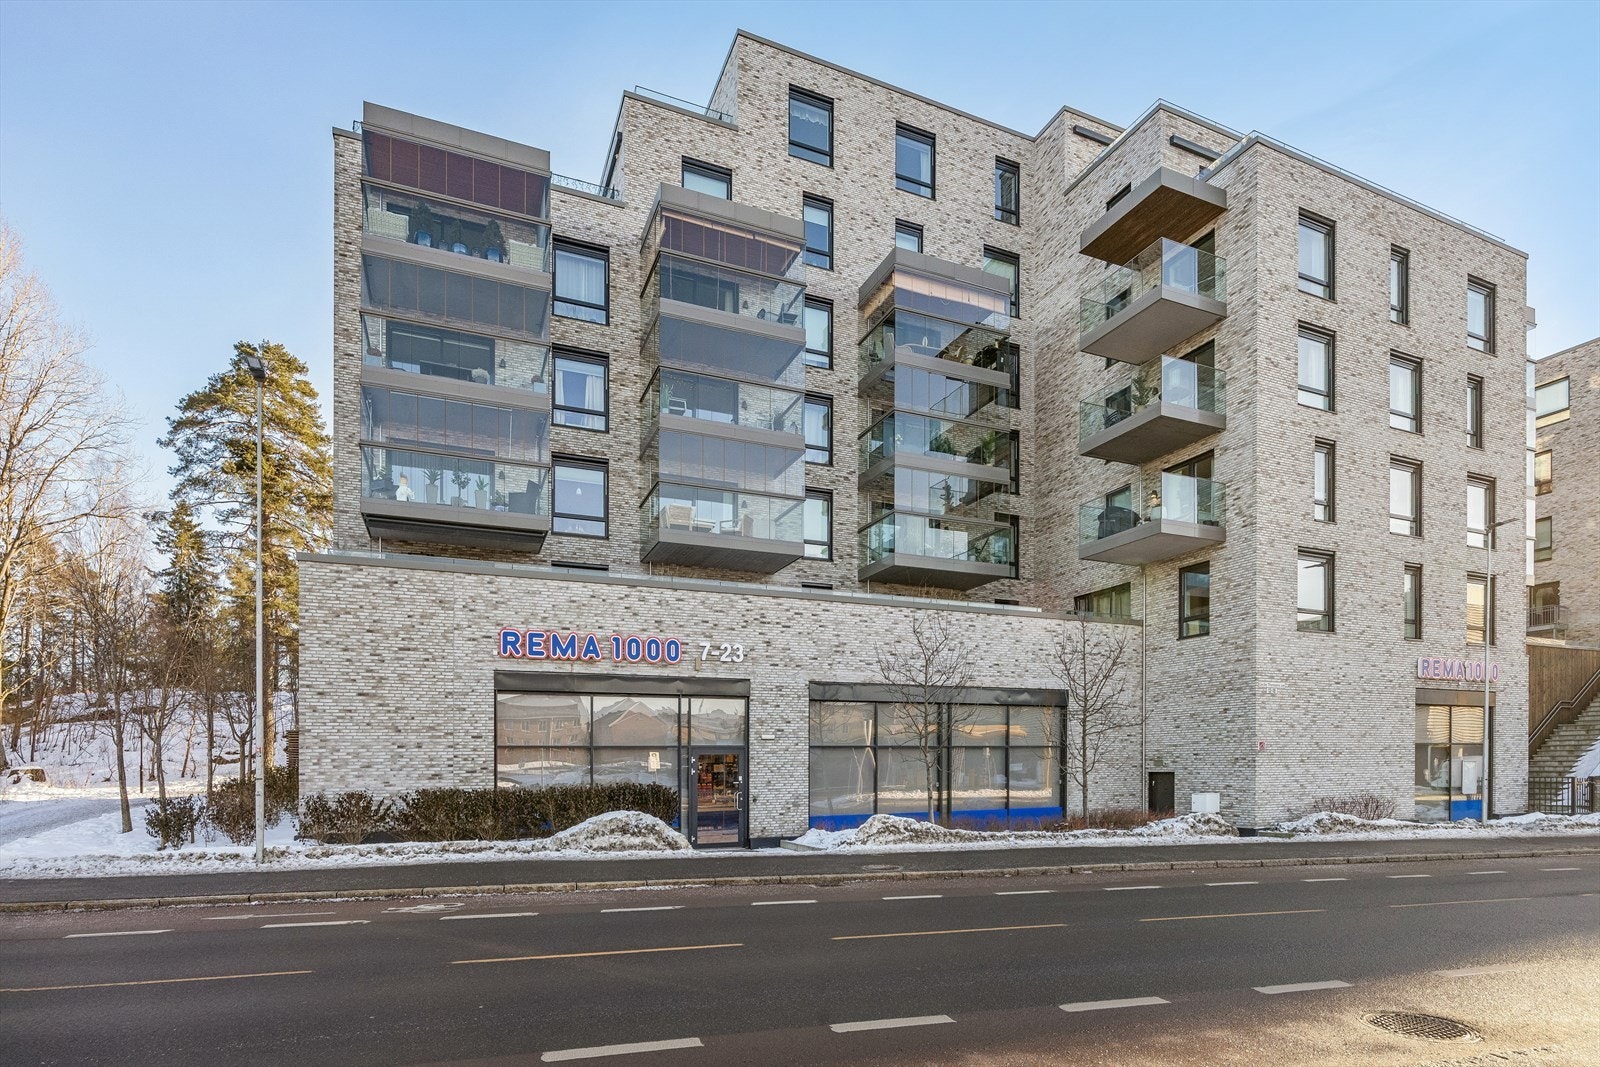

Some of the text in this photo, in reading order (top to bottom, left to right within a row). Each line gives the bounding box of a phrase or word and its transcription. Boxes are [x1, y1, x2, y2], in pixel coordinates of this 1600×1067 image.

[499, 628, 682, 664] REMA 1000
[700, 642, 744, 663] 7-23
[1419, 657, 1499, 682] REMA 100
